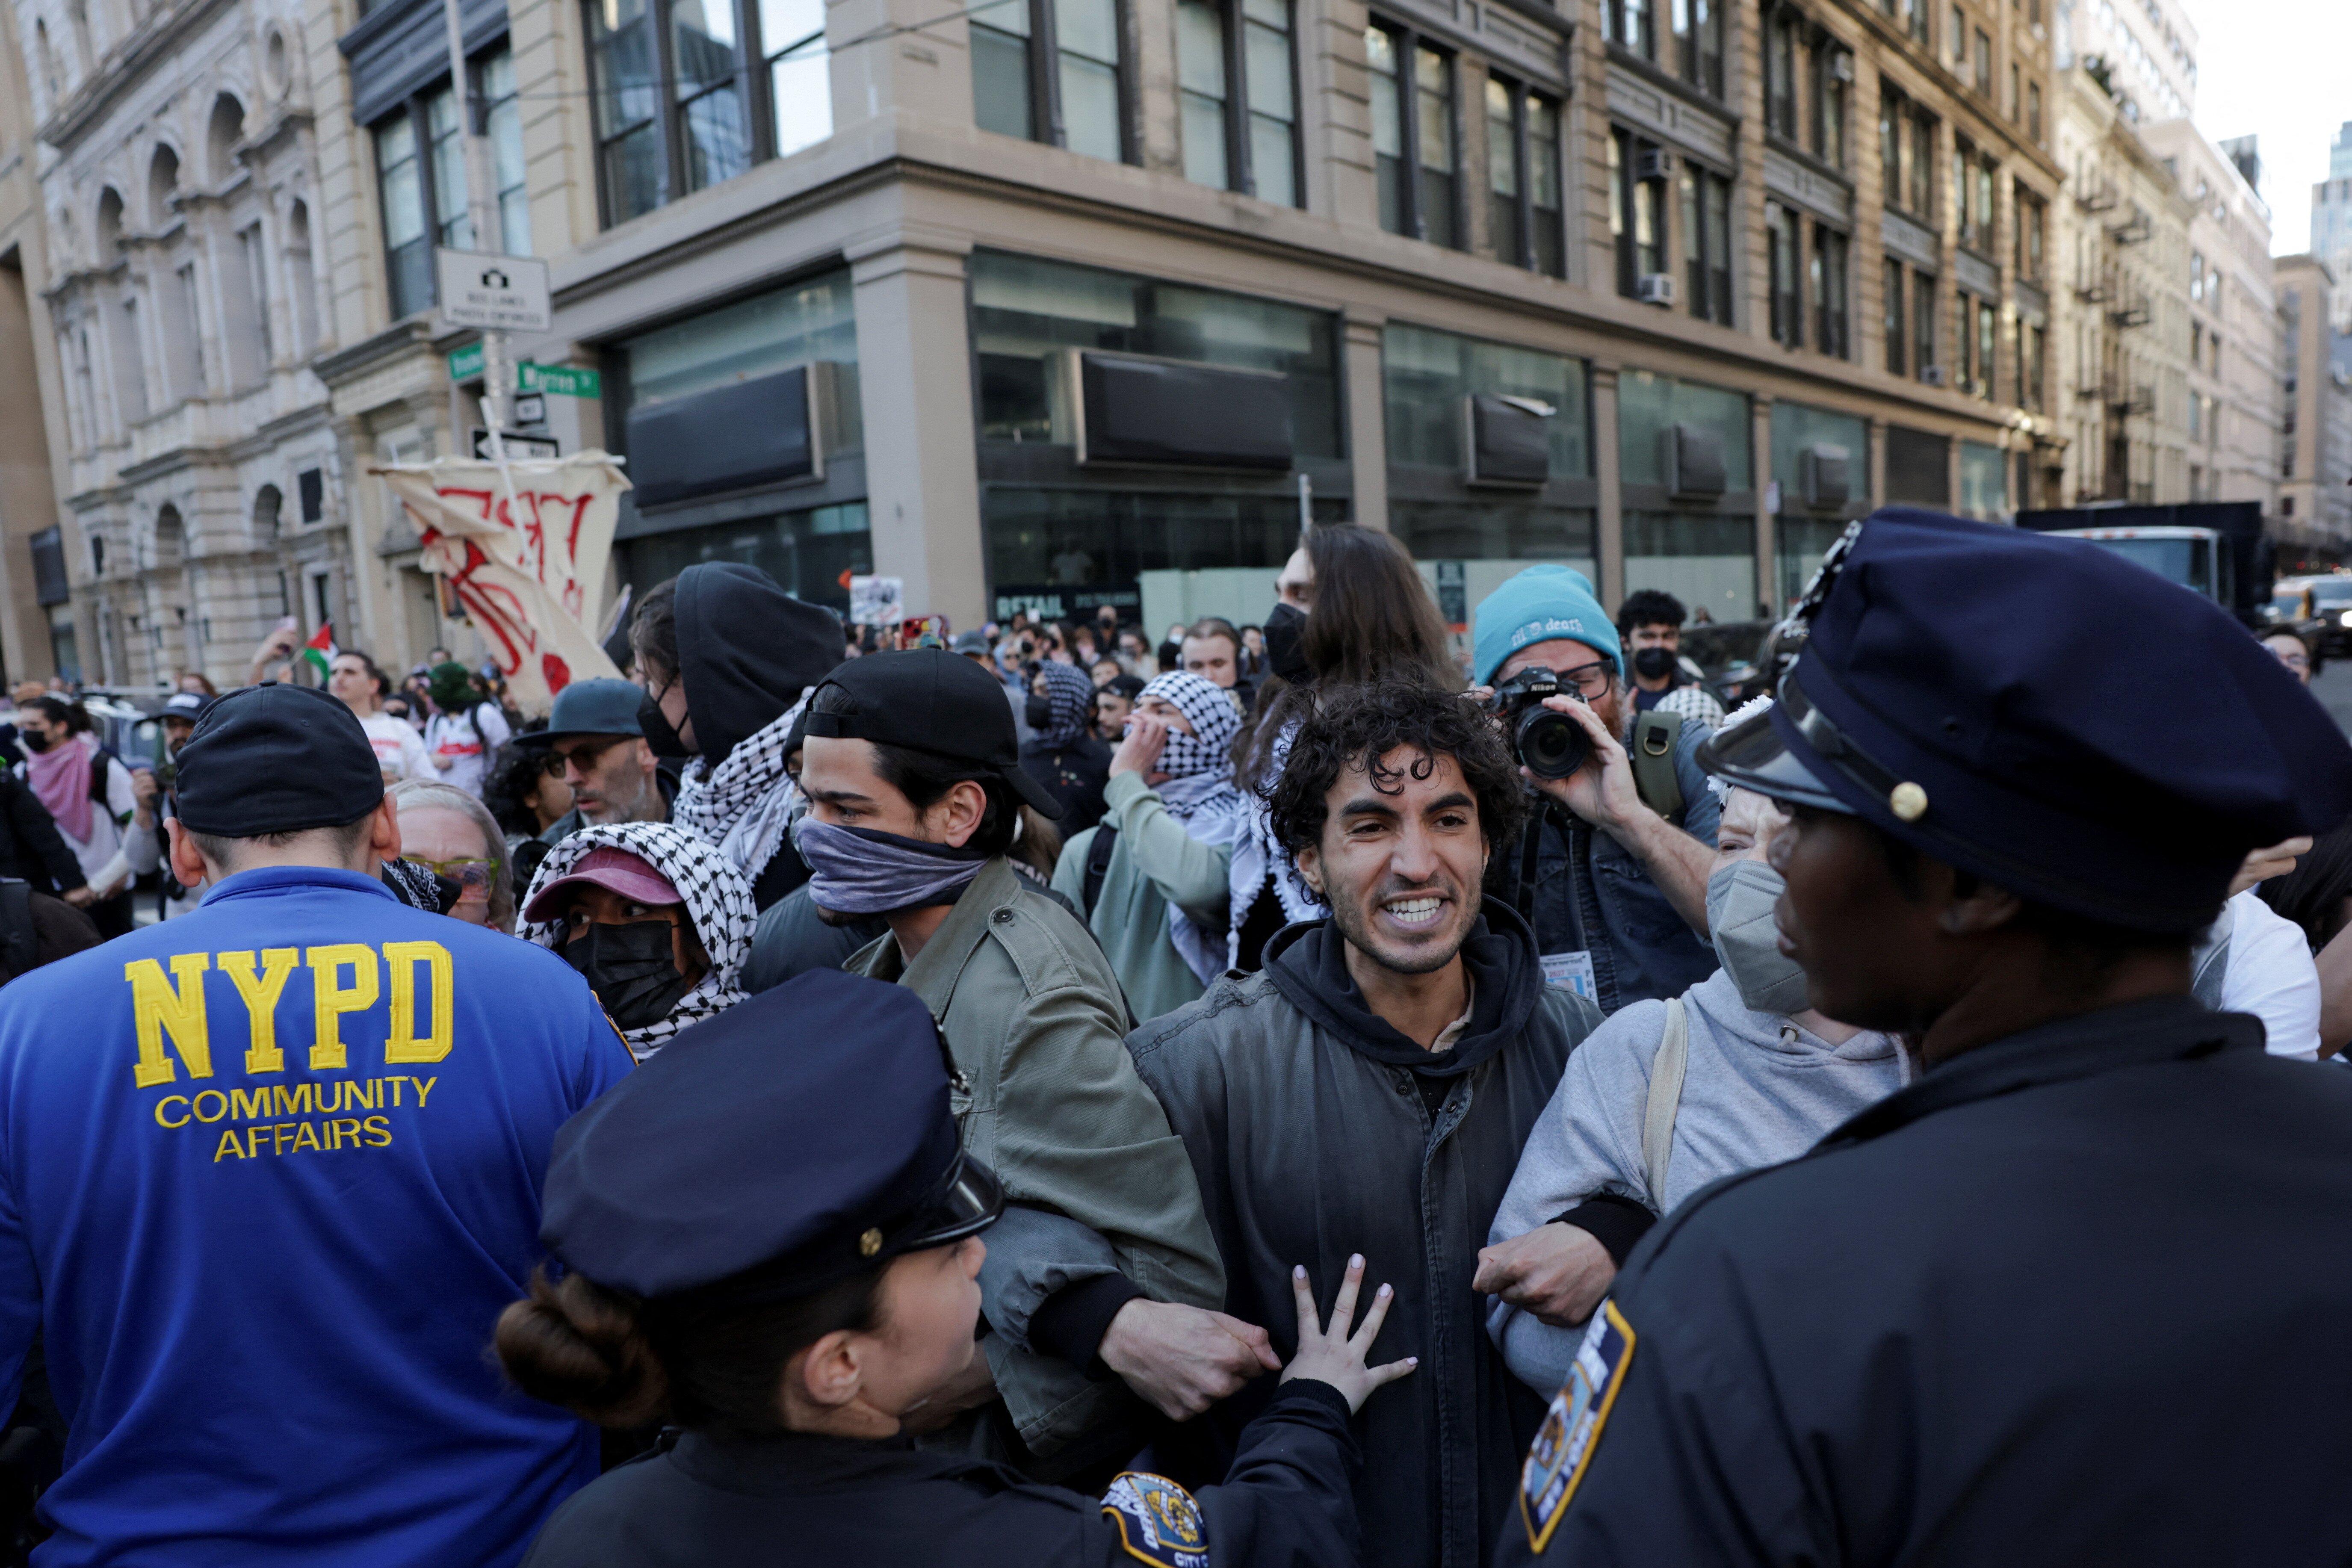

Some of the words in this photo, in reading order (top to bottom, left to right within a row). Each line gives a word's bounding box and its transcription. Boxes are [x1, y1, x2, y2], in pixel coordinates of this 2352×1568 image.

[523, 367, 576, 393] Warren
[997, 594, 1067, 620] RETAIL
[1545, 617, 1584, 633] death
[124, 941, 453, 1089] NYPD
[154, 1076, 437, 1128] COMMUNITY
[214, 1115, 392, 1163] AFFAIRS
